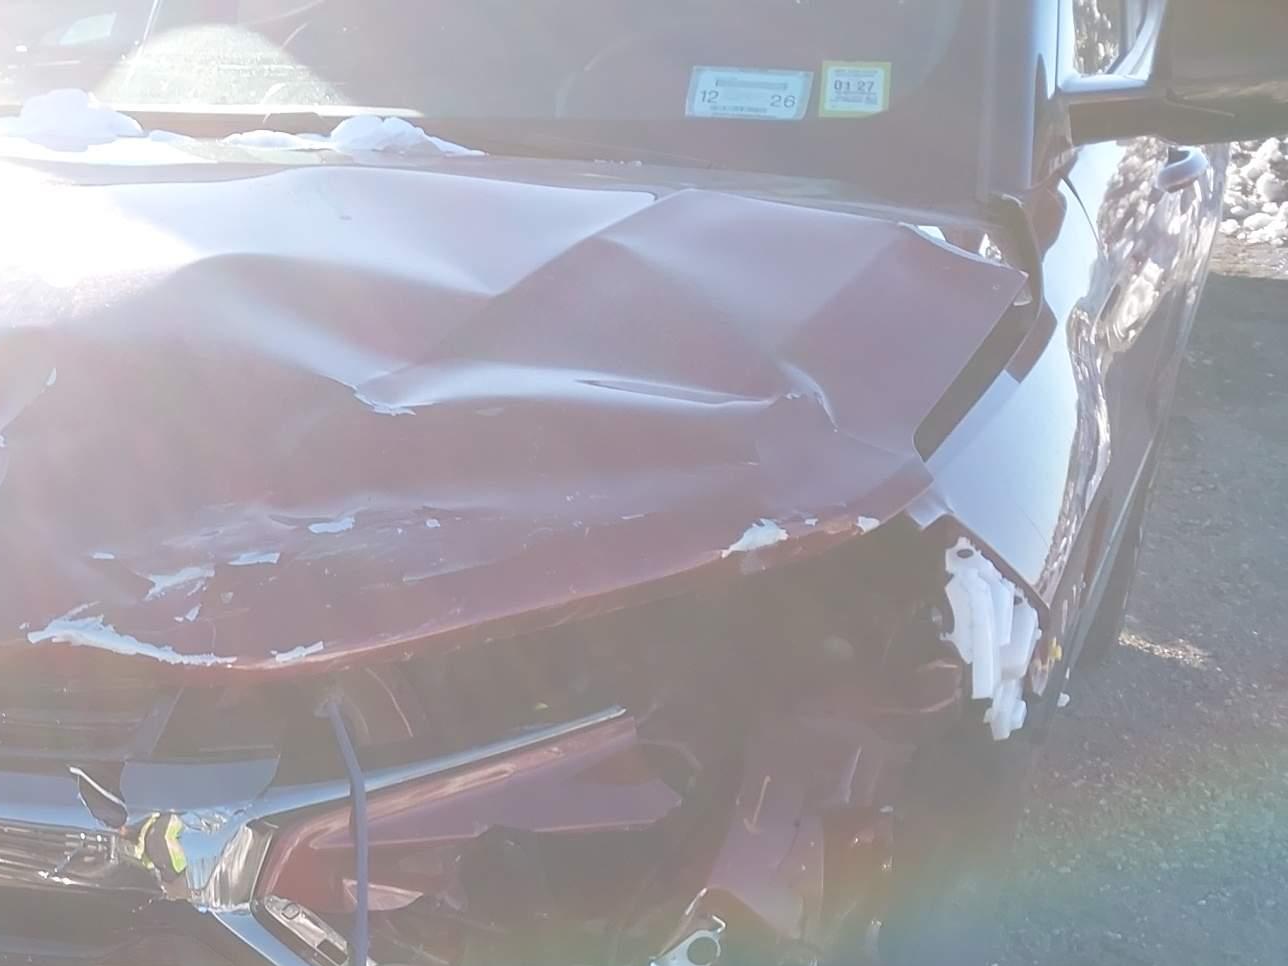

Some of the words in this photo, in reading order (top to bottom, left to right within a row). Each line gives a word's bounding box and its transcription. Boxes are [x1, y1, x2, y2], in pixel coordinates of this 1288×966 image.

[856, 80, 875, 92] 27
[700, 89, 719, 104] 12
[769, 94, 796, 109] 26
